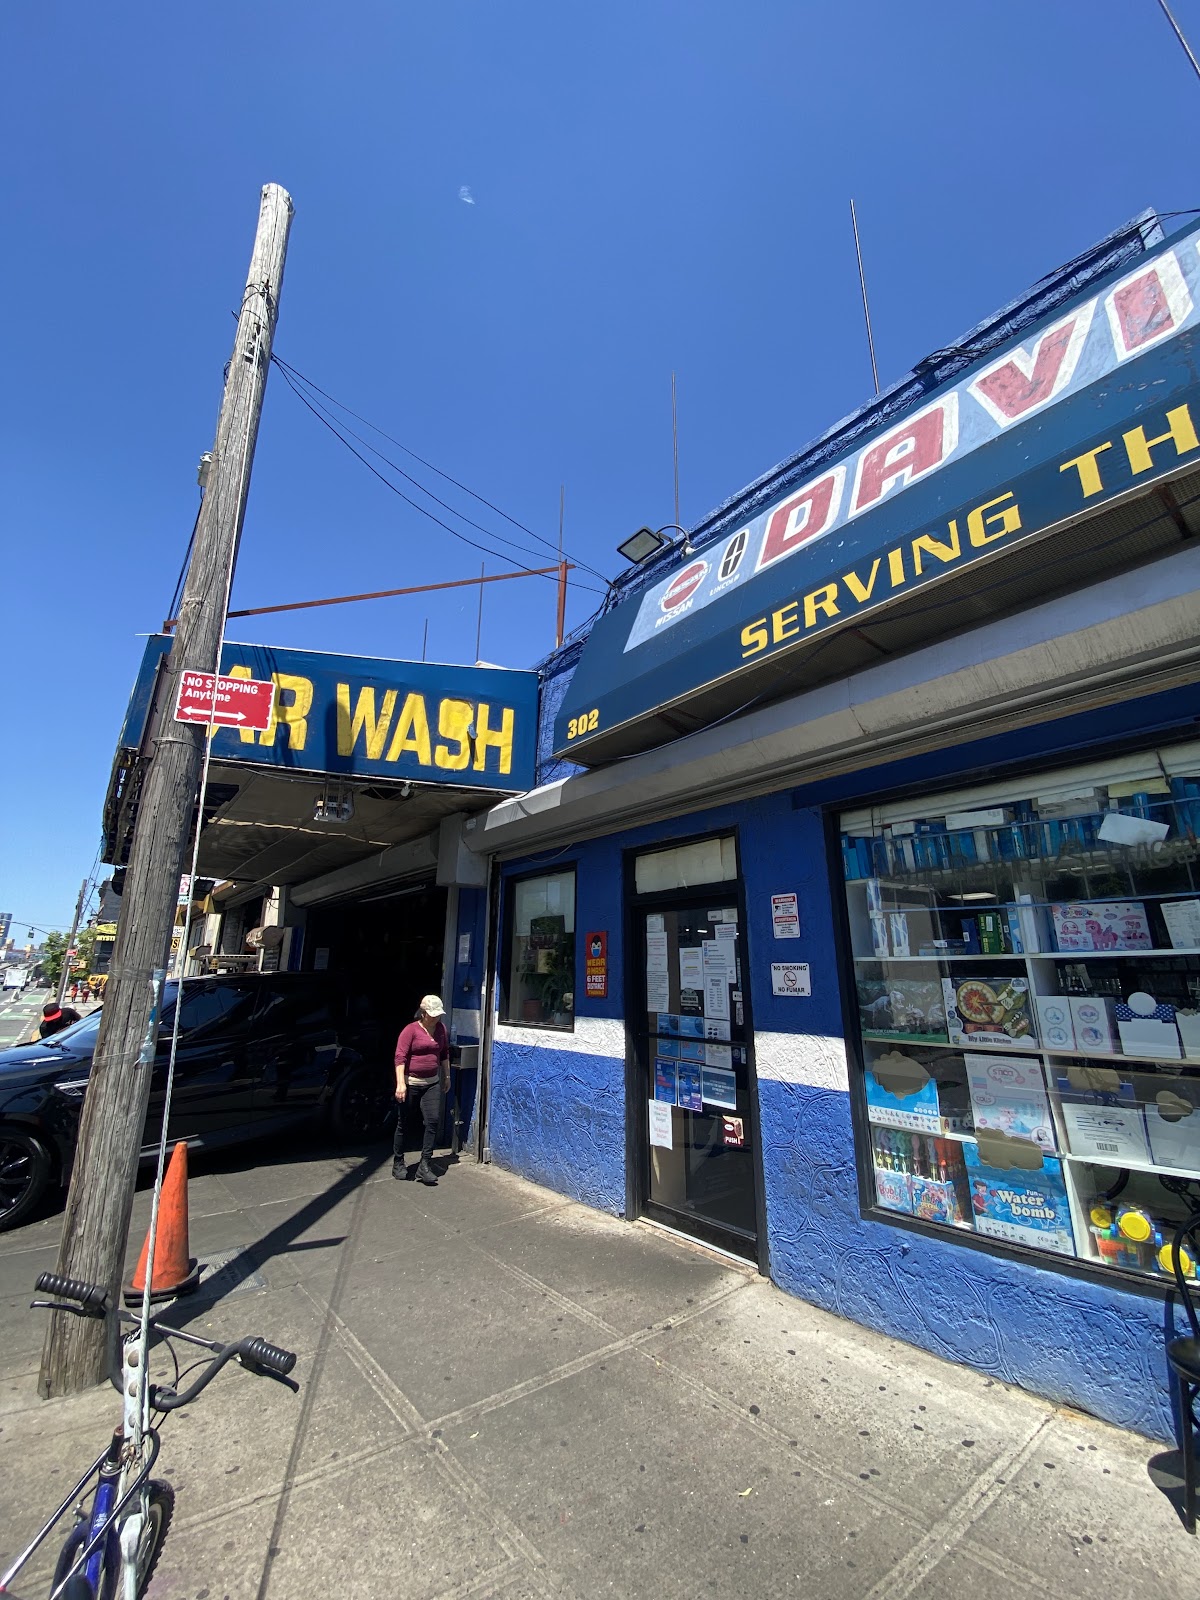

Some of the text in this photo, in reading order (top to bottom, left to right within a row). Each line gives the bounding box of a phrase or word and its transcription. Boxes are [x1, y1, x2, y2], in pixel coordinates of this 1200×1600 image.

[740, 490, 1022, 659] SERVING
[654, 598, 694, 629] NISSAN
[186, 676, 203, 688] NO
[184, 688, 231, 702] Anytime
[336, 682, 515, 775] WASH
[567, 708, 599, 740] 302
[586, 975, 605, 983] 6 FEET
[967, 1035, 978, 1043] My
[979, 1036, 993, 1044] Little
[725, 1136, 738, 1145] PUSH
[997, 1189, 1045, 1207] Water
[1026, 1189, 1039, 1197] Fun
[1010, 1202, 1056, 1220] bomb
